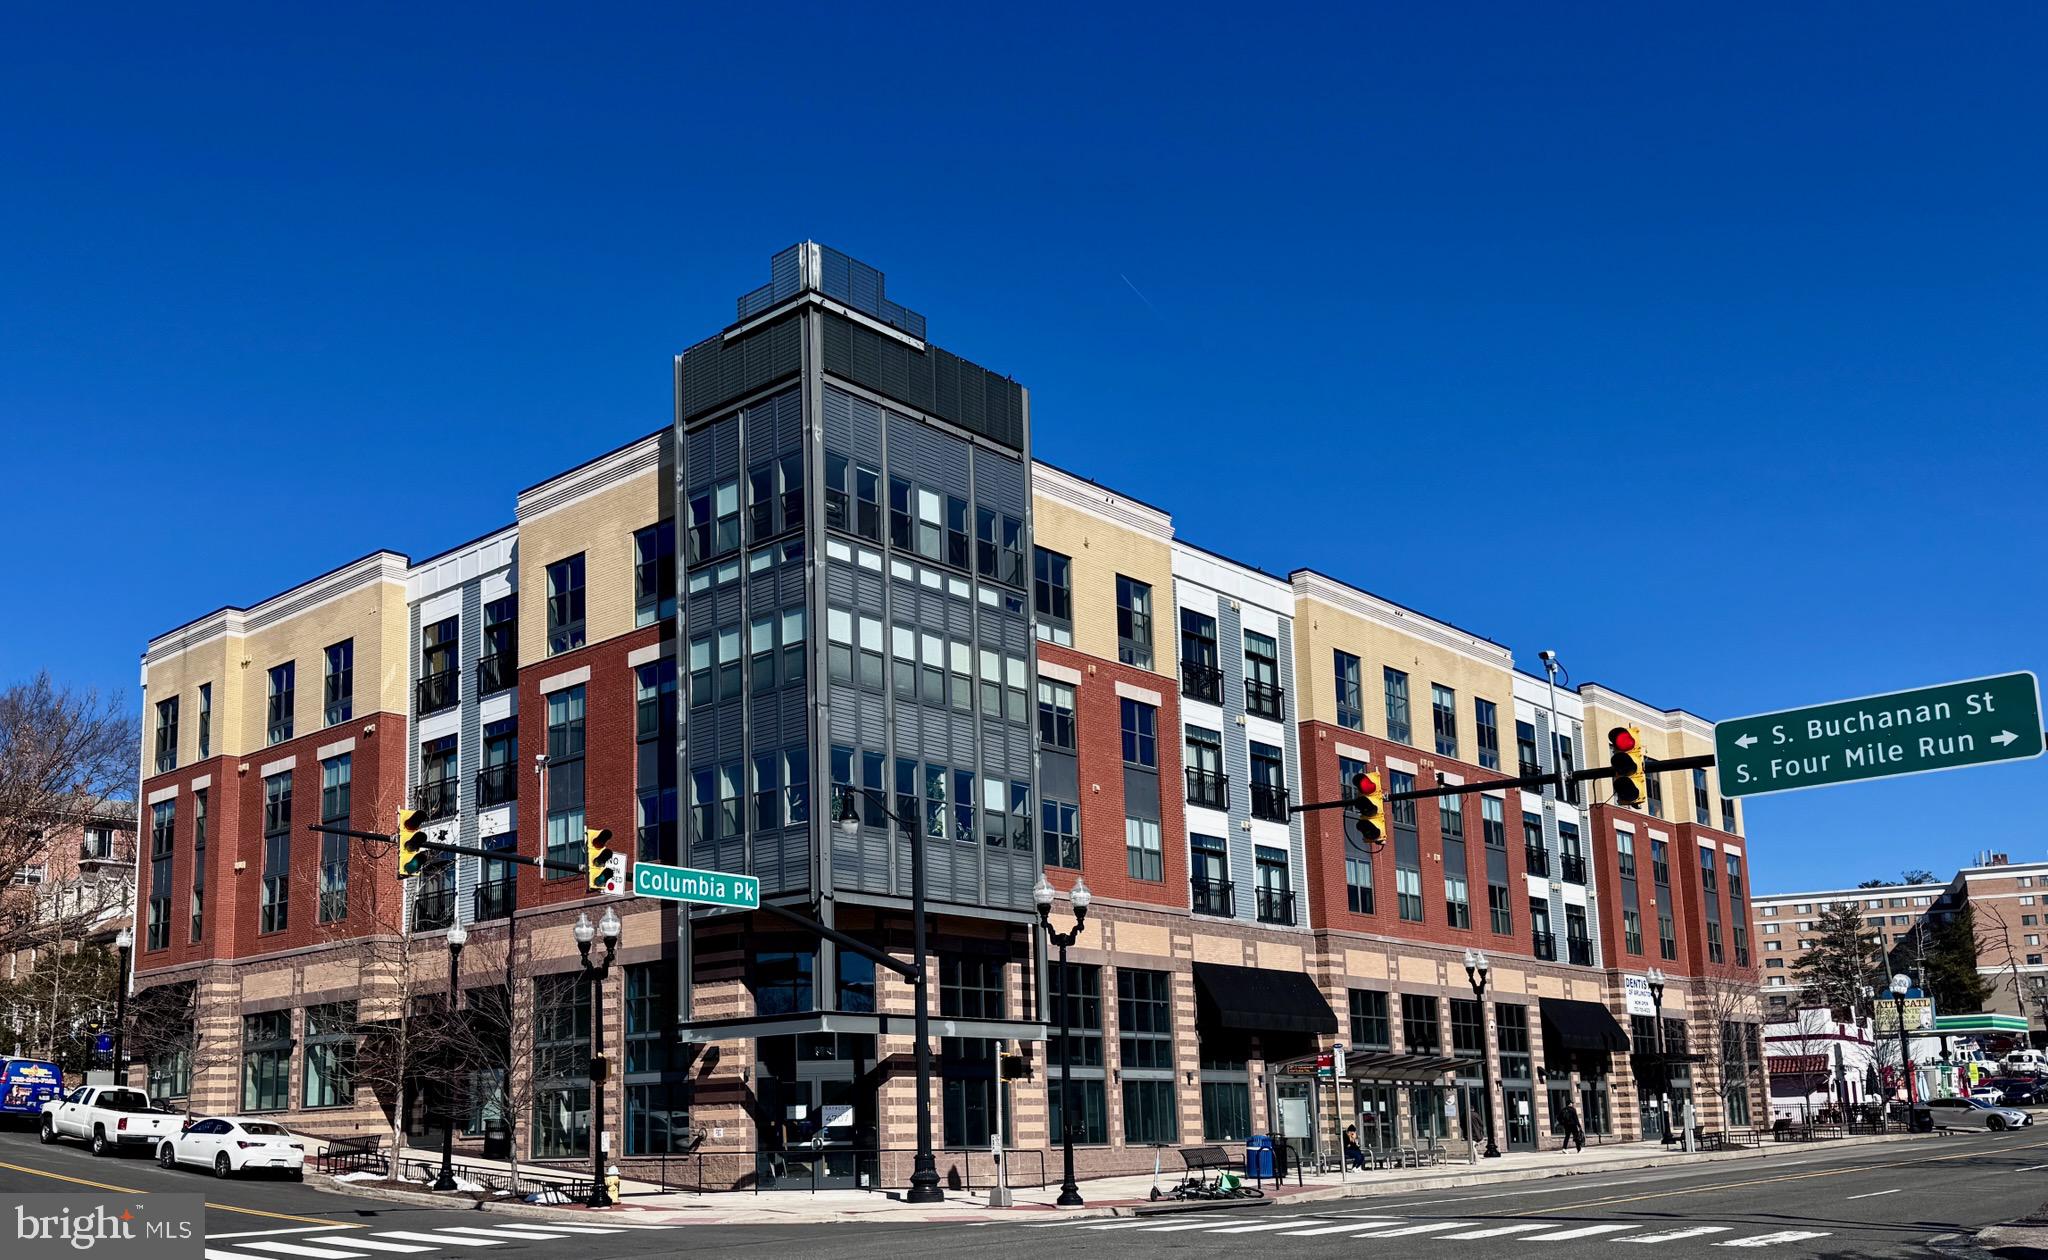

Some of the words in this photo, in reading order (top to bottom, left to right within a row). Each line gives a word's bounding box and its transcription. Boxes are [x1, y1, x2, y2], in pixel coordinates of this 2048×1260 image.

[1771, 725, 1794, 745] S.
[1807, 701, 1951, 740] Buchanan
[1966, 691, 1996, 715] St
[1737, 763, 1758, 783] S.
[1770, 753, 1831, 779] Four
[1845, 743, 1904, 769] Mile
[1918, 734, 1975, 758] Run
[639, 870, 726, 898] Columbia
[734, 881, 754, 902] Pk
[1625, 977, 1649, 990] DENTIS
